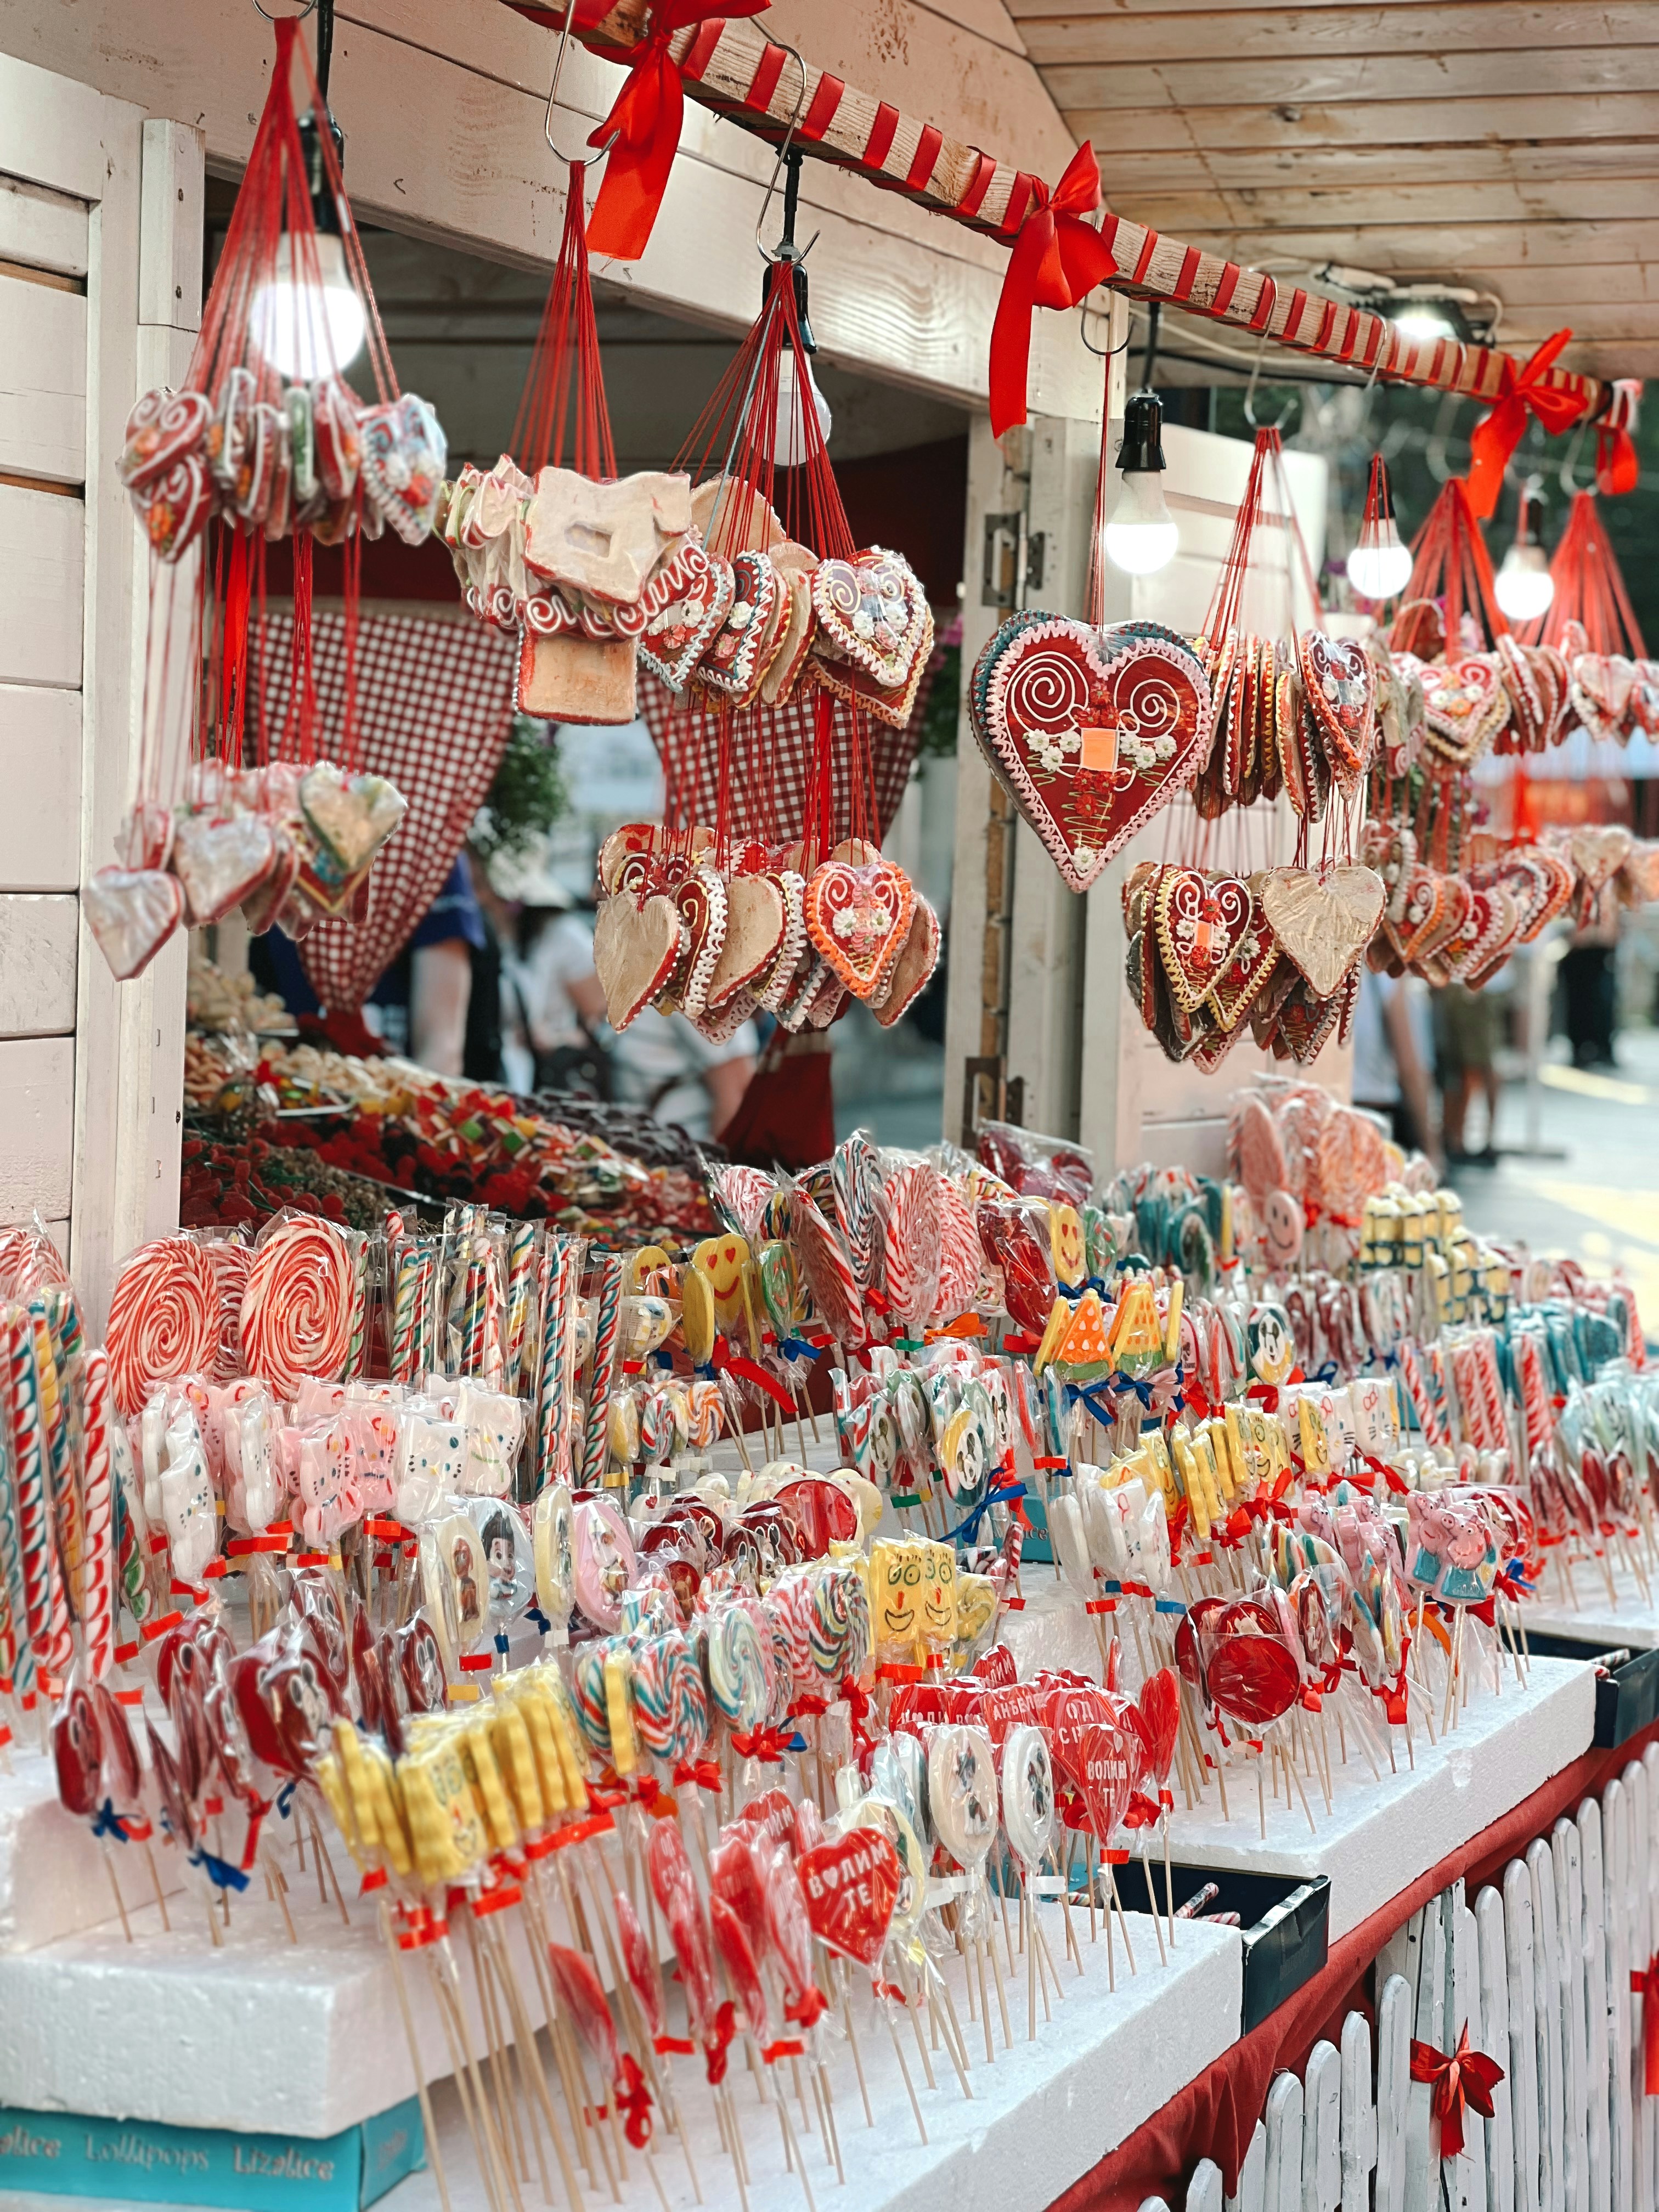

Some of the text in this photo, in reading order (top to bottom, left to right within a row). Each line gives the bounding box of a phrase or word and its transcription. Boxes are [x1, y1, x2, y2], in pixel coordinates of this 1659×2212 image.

[1103, 1787, 1116, 1808] ТЕ
[843, 1883, 873, 1912] ТЕ
[84, 2132, 210, 2175] Lollipops
[233, 2144, 335, 2182] Lizalice
